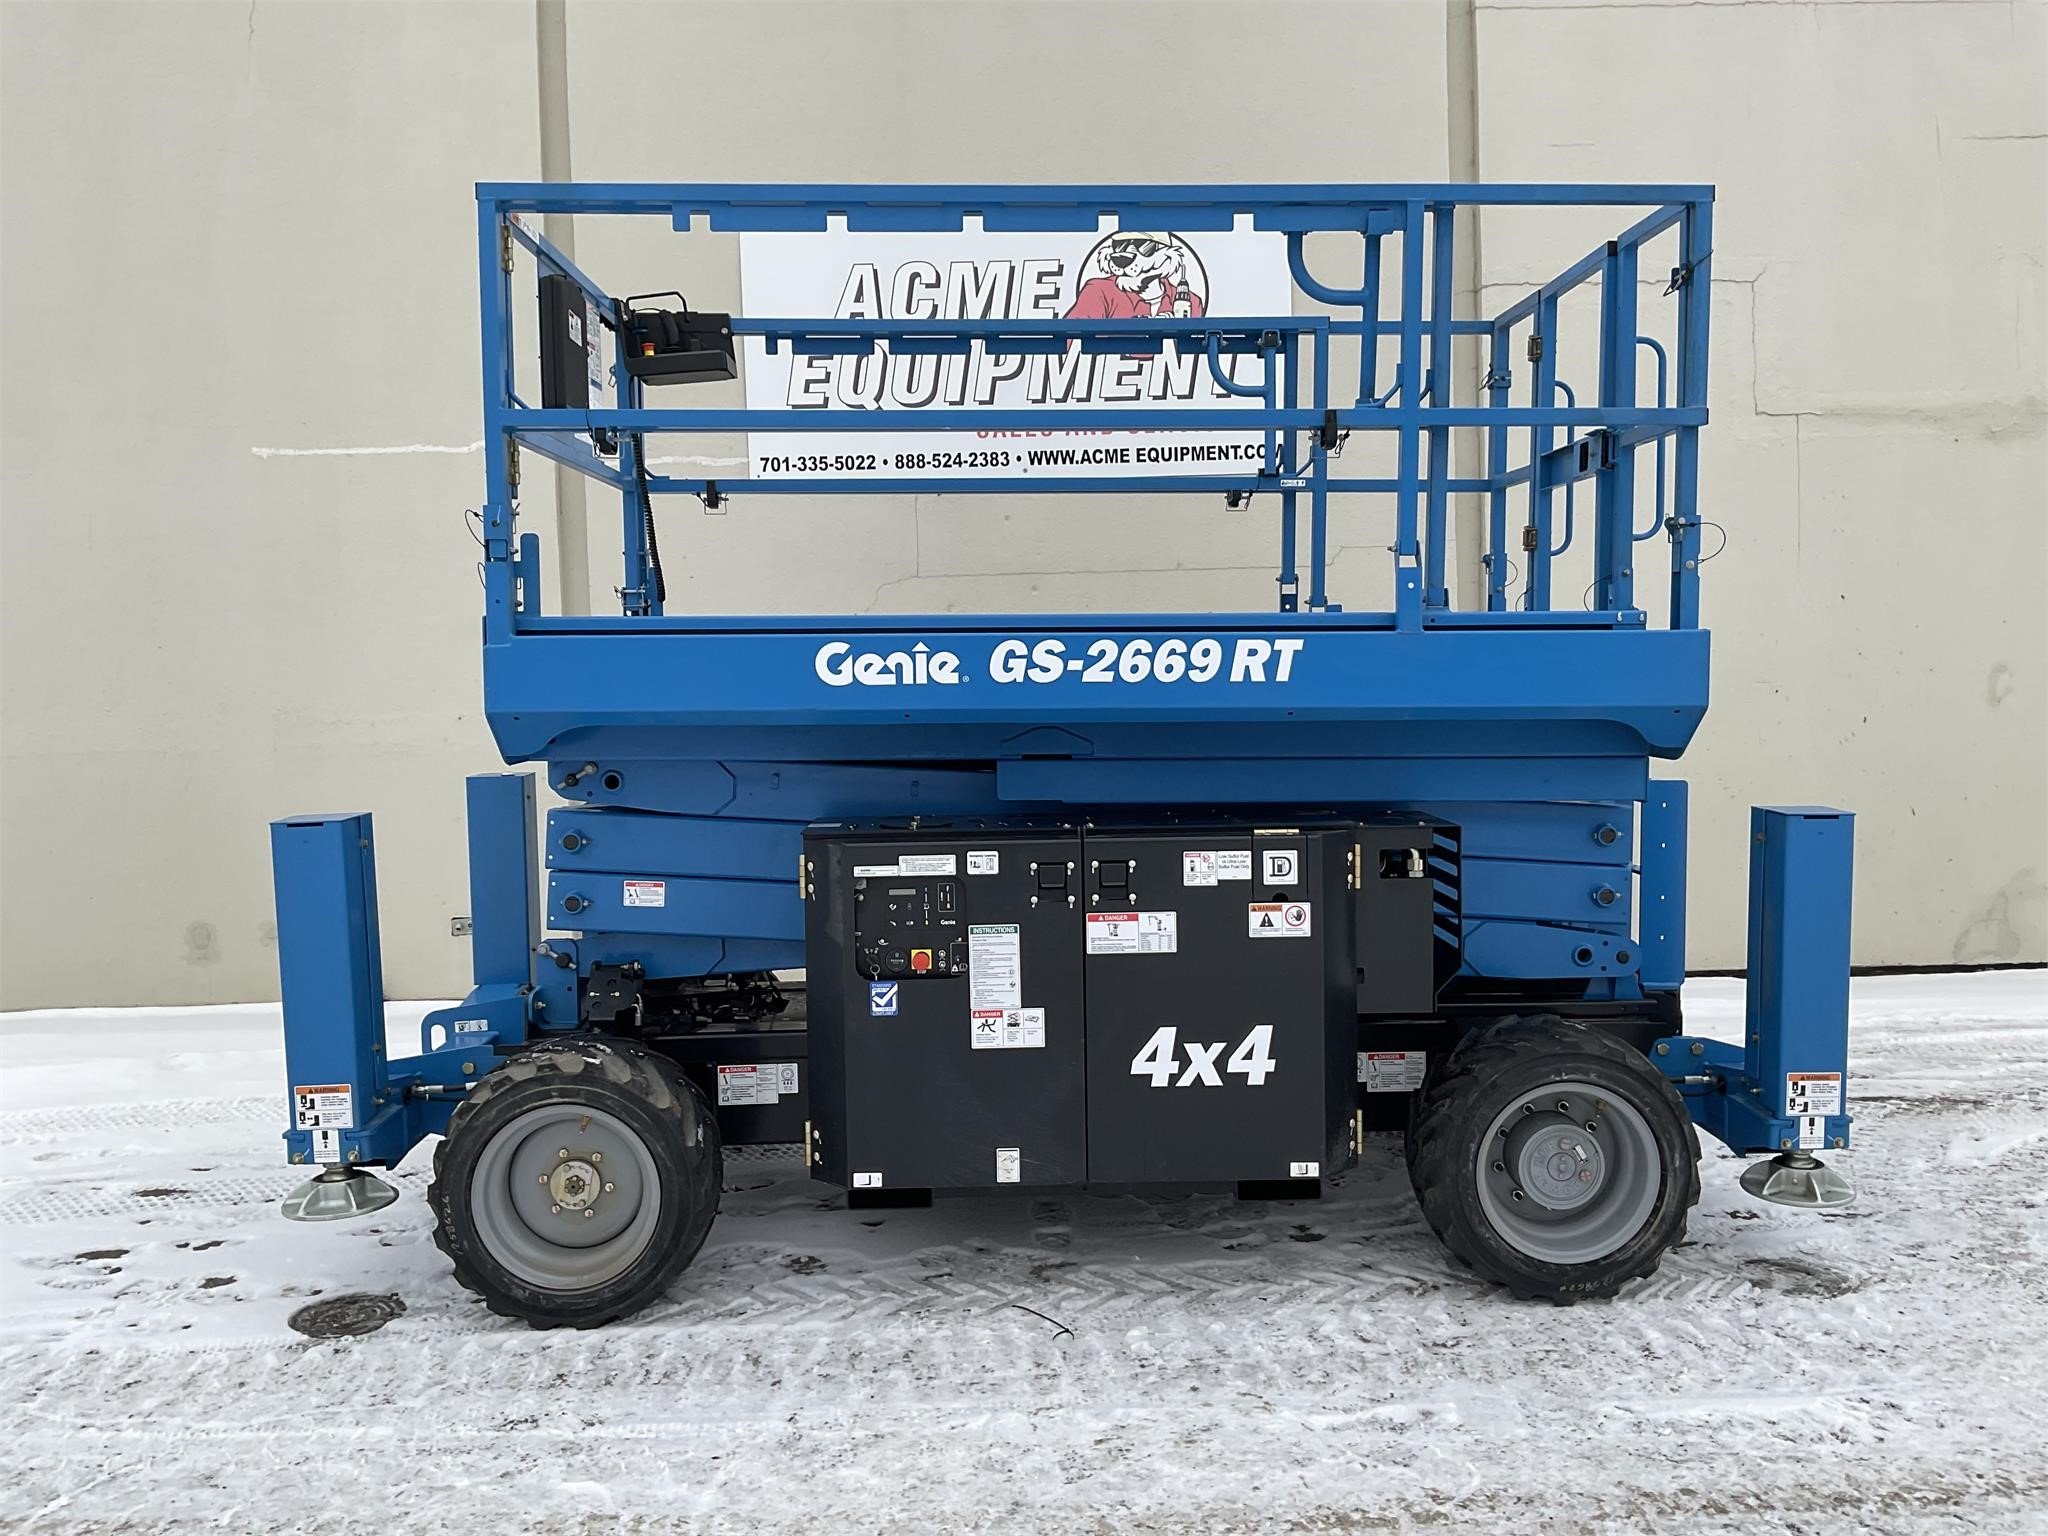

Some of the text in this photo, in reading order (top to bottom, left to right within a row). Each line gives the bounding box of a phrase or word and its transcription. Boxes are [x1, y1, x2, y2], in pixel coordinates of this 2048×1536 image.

[834, 258, 1063, 320] ACME
[760, 455, 876, 473] 701-335-5022
[894, 451, 1010, 470] 888-524-2383
[1027, 447, 1130, 466] WWW.ACME
[988, 637, 1223, 684] GS-2669
[1230, 637, 1305, 683] RT
[1130, 1024, 1277, 1088] 4x4
